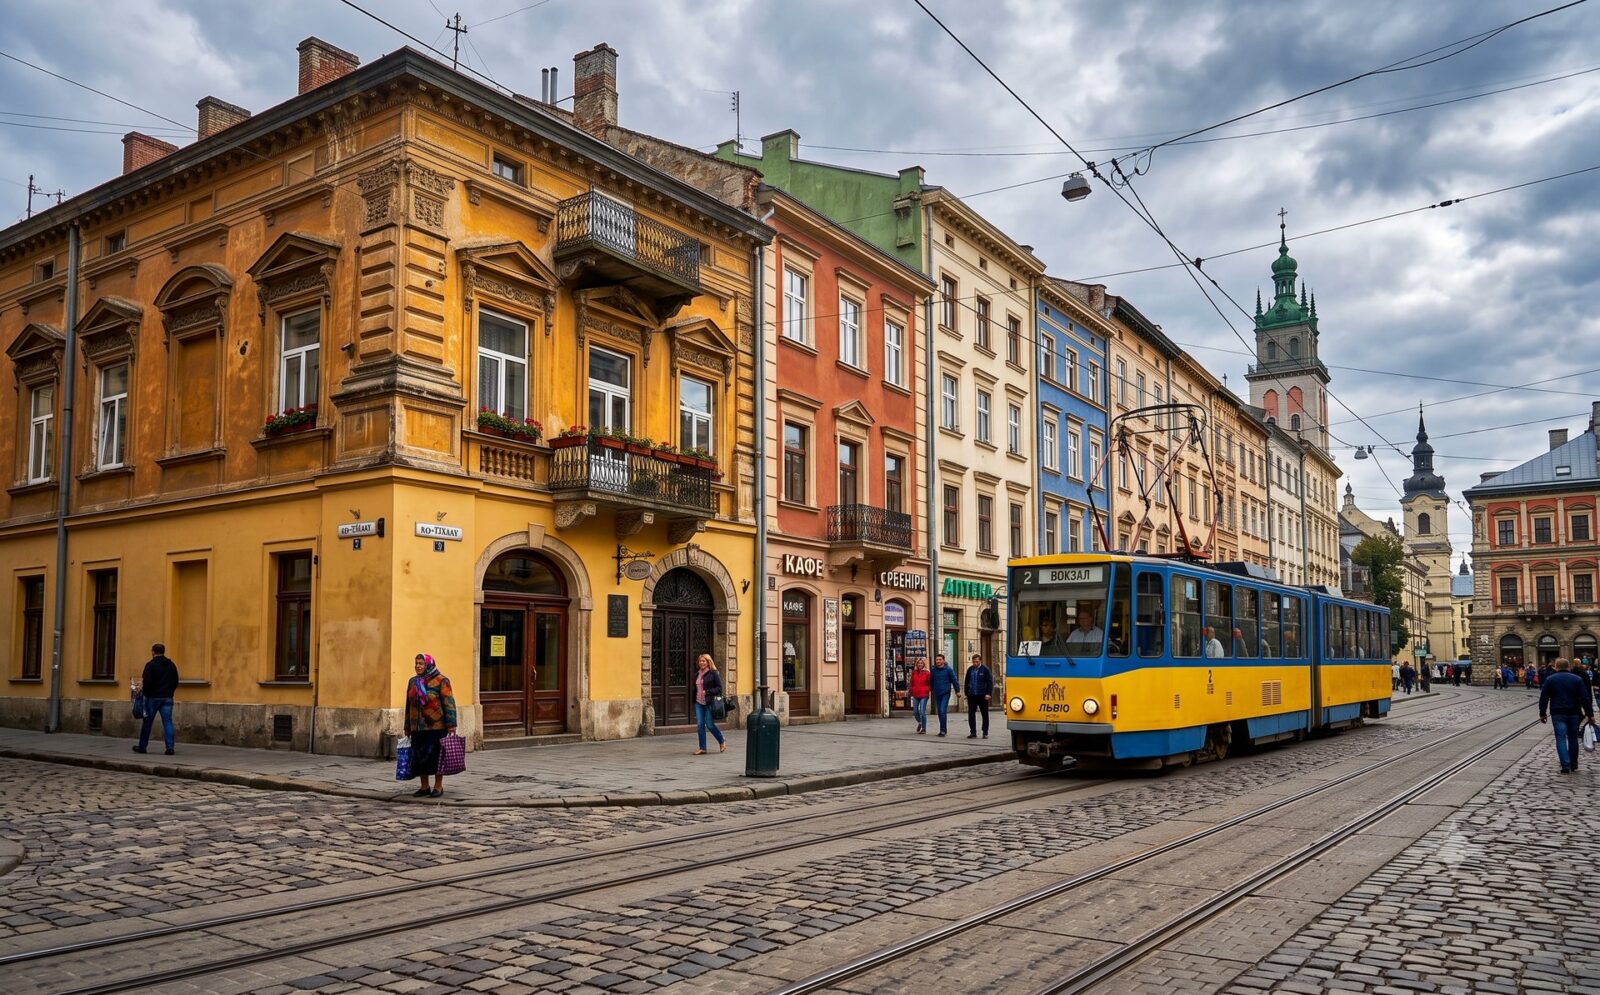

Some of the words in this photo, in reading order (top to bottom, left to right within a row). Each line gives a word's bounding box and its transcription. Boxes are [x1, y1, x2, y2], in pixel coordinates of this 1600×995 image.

[785, 554, 823, 577] КАФЕ
[1023, 571, 1032, 585] 2
[1050, 569, 1090, 582] ВОКЗАЛ
[942, 577, 993, 600] АПТЕКА
[783, 601, 804, 612] КАФЕ
